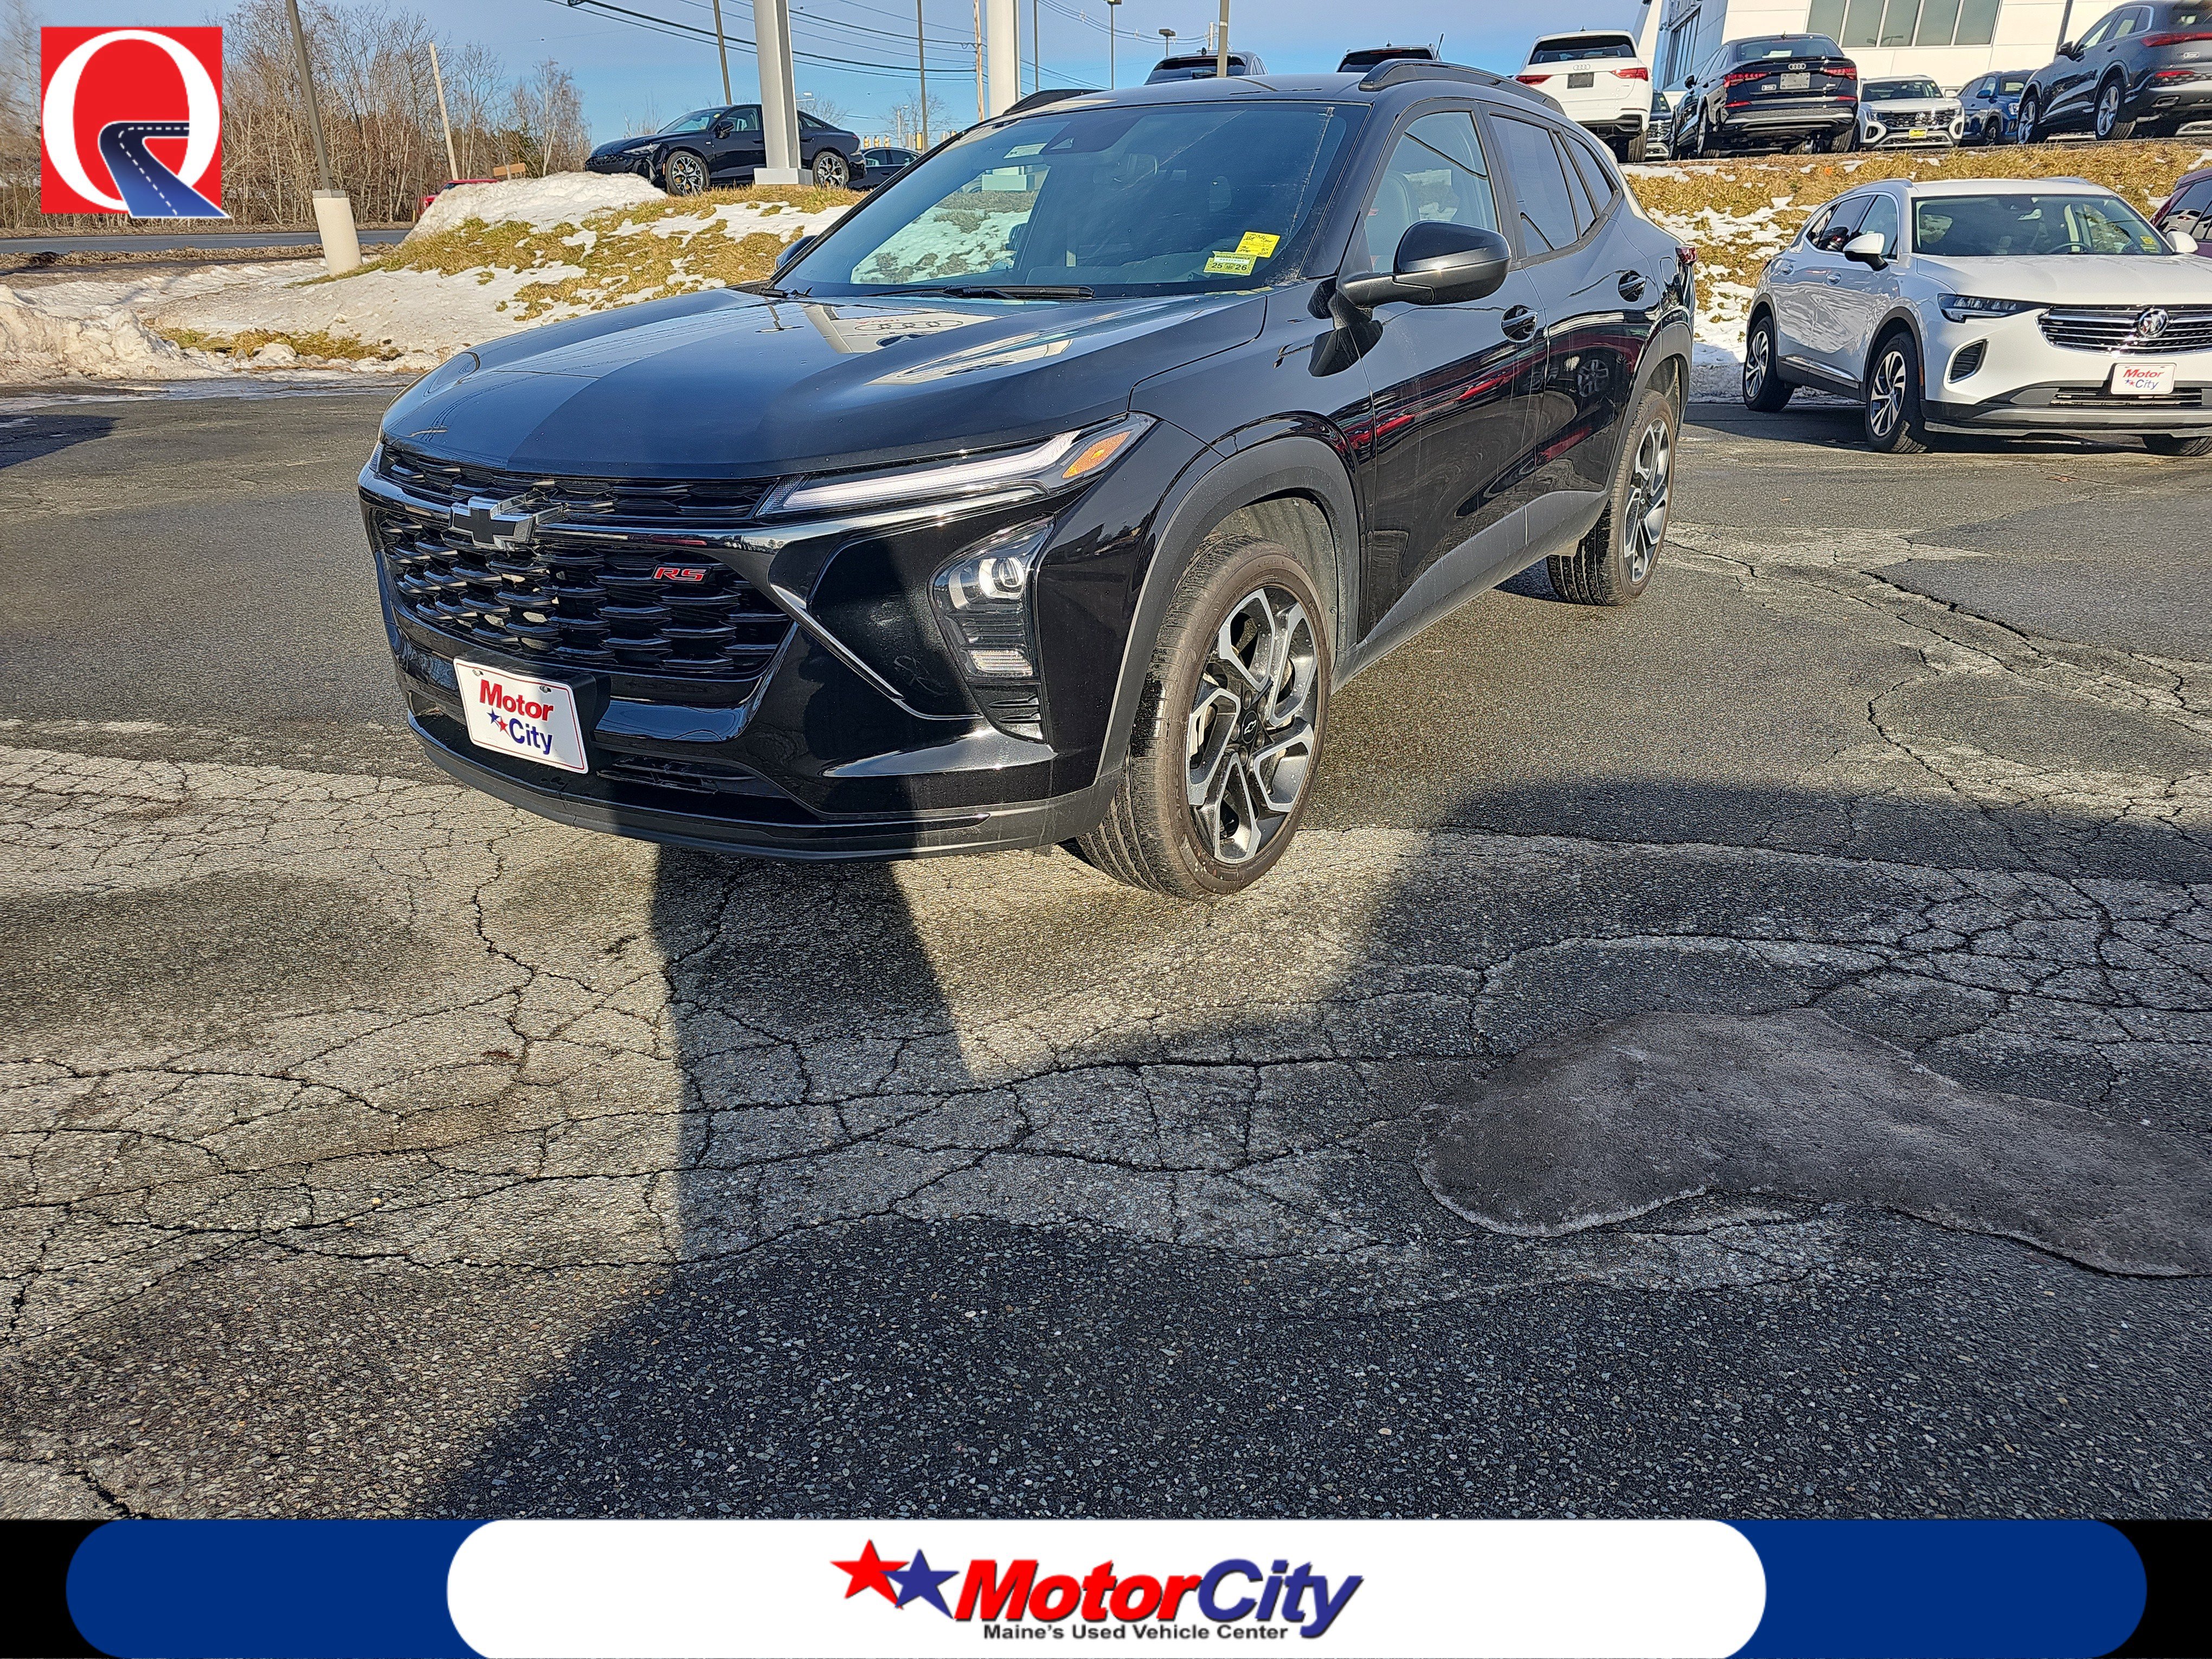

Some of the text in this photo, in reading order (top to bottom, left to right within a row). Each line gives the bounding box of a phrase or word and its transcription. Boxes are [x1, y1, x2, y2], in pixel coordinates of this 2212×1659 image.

[2123, 369, 2165, 378] Motor
[2135, 380, 2160, 390] City
[653, 567, 706, 582] RS
[480, 679, 554, 721] Motor
[509, 718, 552, 755] City
